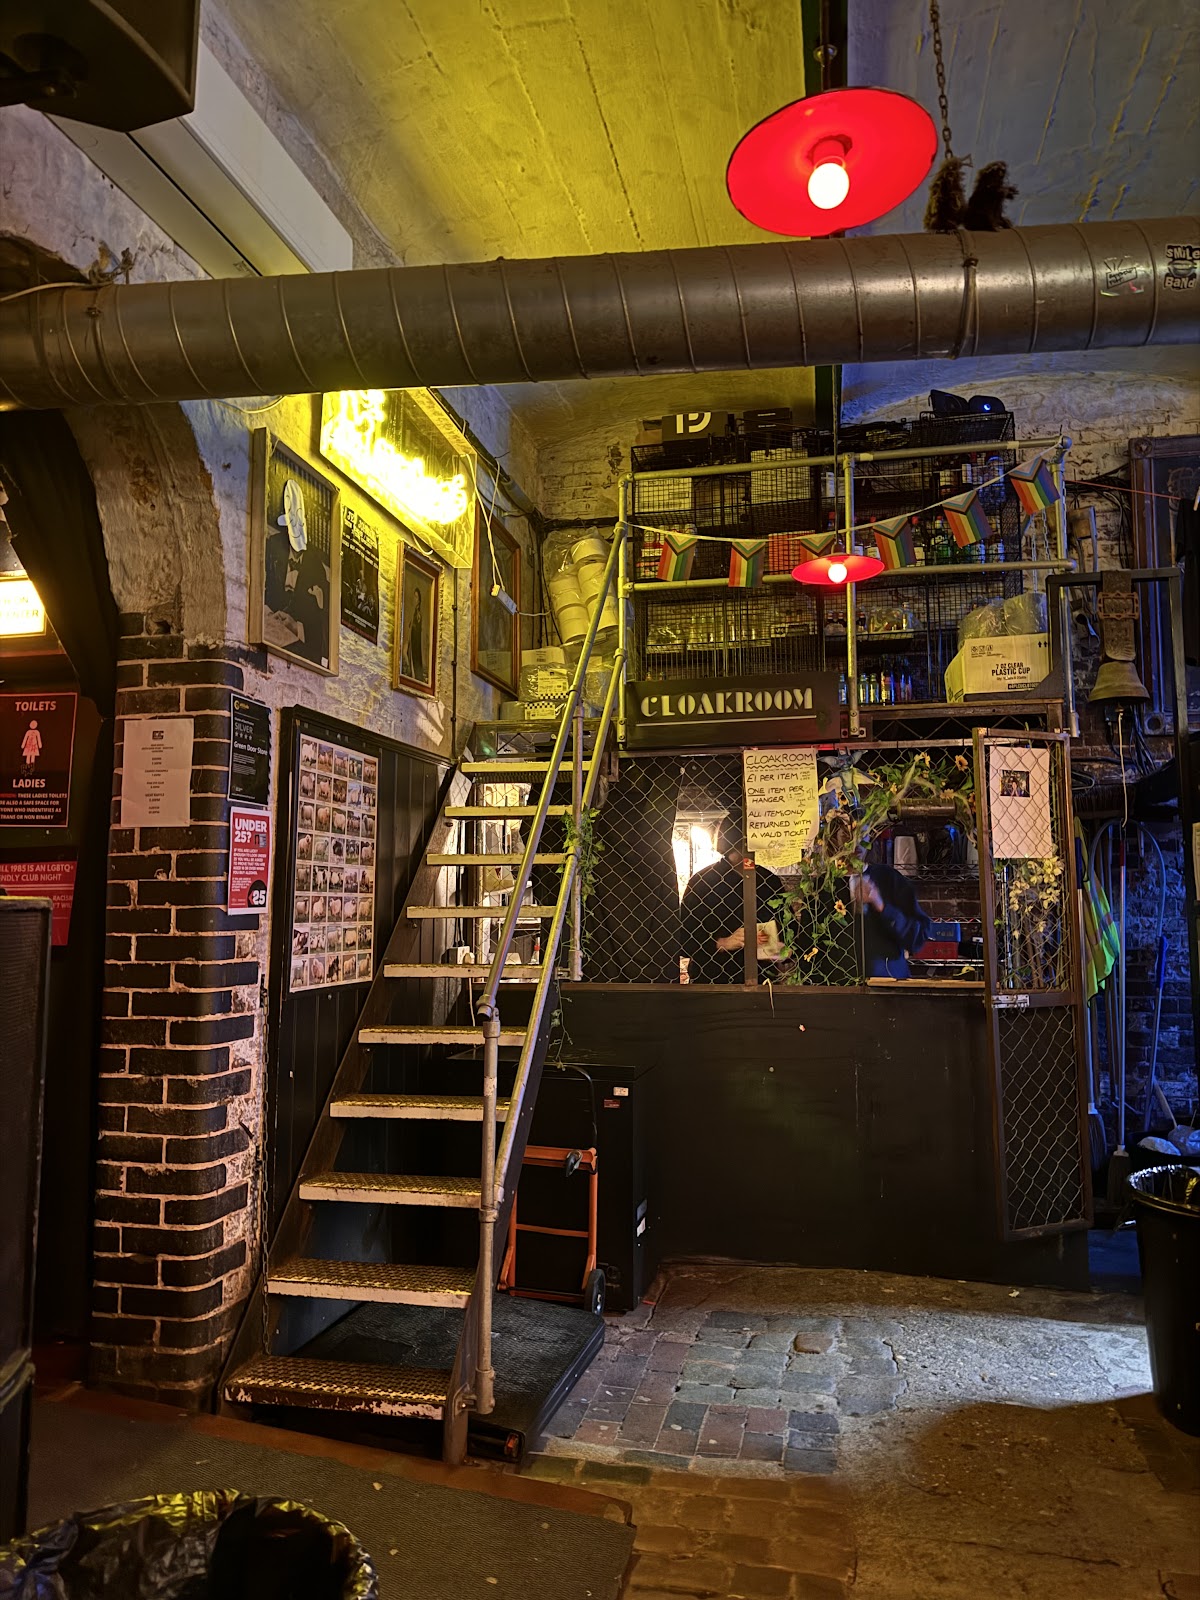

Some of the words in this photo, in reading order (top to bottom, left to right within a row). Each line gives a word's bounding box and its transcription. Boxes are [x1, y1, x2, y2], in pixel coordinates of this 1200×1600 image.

[992, 668, 1016, 676] PLASTIC
[15, 701, 57, 712] TOILETS
[640, 688, 813, 717] CLOAKROOM
[235, 722, 254, 734] SILVER
[234, 741, 246, 750] Green
[247, 744, 257, 753] Door
[746, 754, 814, 765] CLOAKROOM
[12, 778, 46, 788] LADIES
[760, 774, 775, 782] PER
[235, 818, 267, 832] UNDER
[749, 821, 790, 829] RETURNED
[234, 831, 251, 843] 25?
[253, 890, 266, 905] 25
